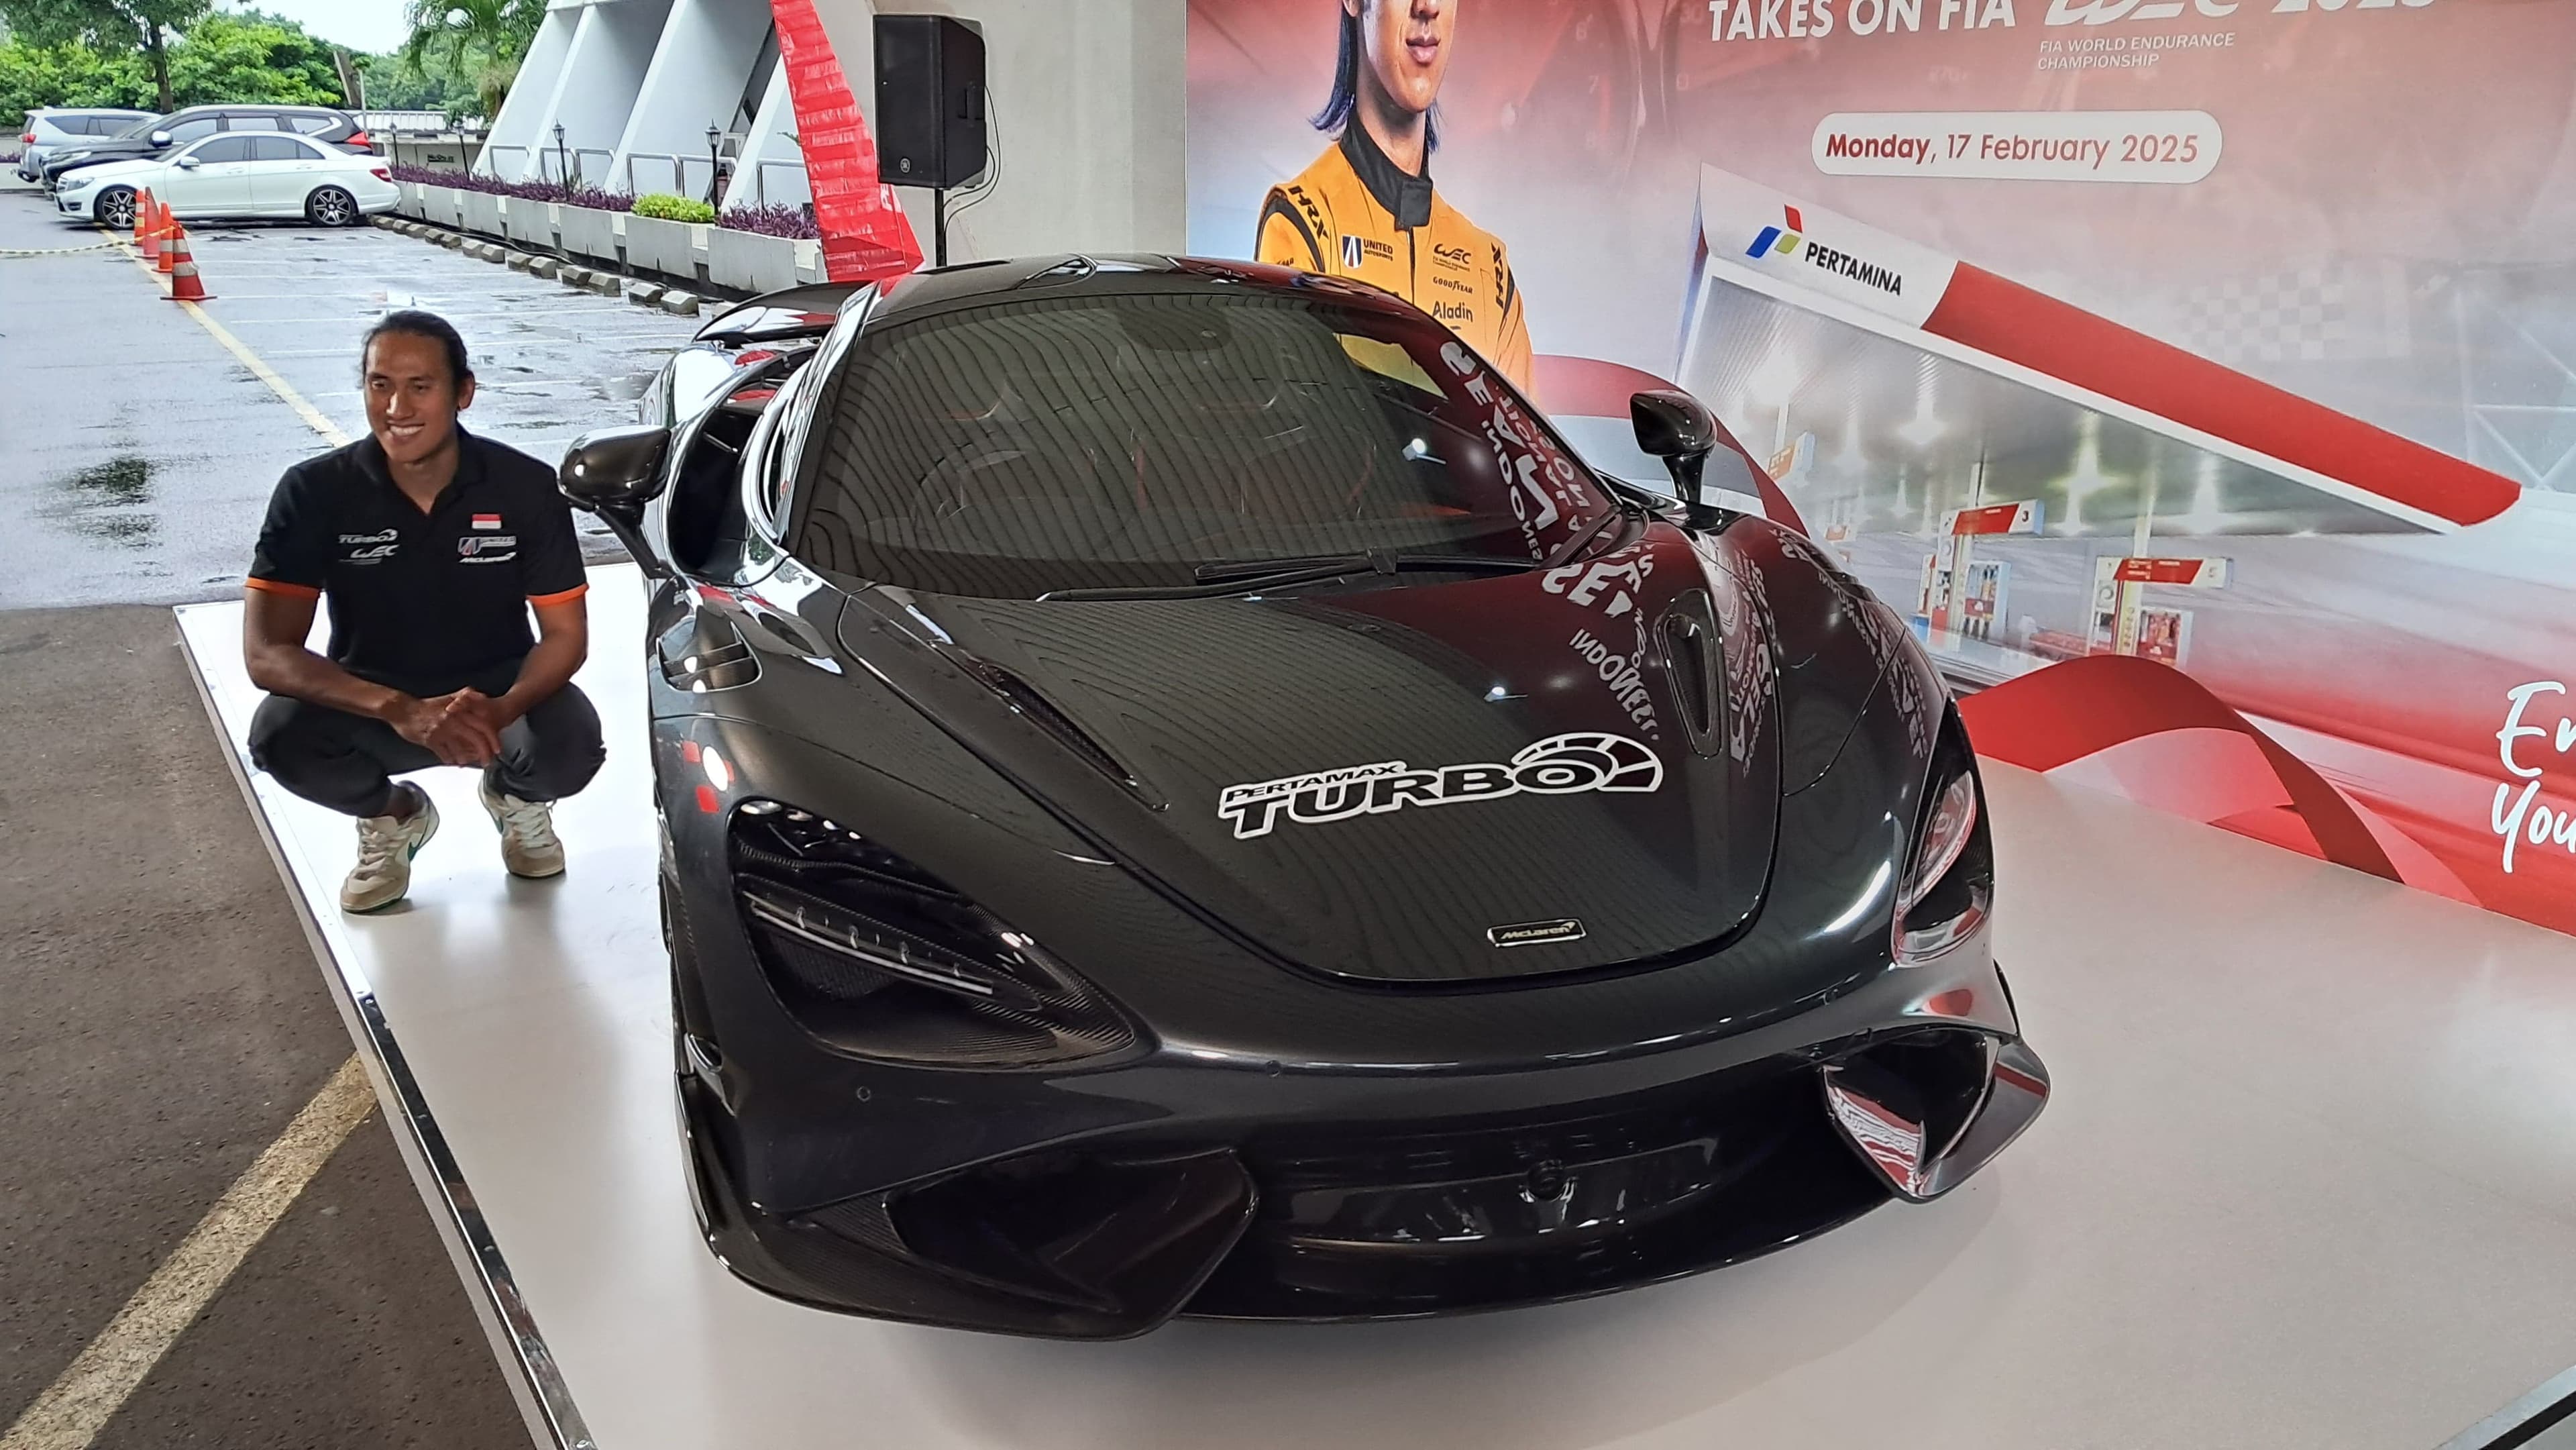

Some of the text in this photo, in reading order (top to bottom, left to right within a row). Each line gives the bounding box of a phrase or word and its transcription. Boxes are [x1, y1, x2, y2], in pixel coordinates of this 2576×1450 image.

[1709, 0, 1835, 42] TAKES
[1847, 0, 1923, 36] ON
[1939, 0, 2017, 30] FIA
[2040, 32, 2236, 54] FIA WORLD ENDURANCE
[2038, 53, 2159, 70] CHAMPIONSHIP
[1825, 134, 2198, 170] Monday, 17 February 2025
[1363, 238, 1393, 254] UNITED
[1434, 244, 1472, 264] WEC
[1805, 241, 1902, 297] PERTAMINA
[1432, 300, 1473, 323] Aladin
[350, 544, 400, 558] WEC
[1225, 764, 1402, 803] PERTAMAX
[1220, 758, 1617, 839] TURBO
[1500, 921, 1576, 939] McLaren
